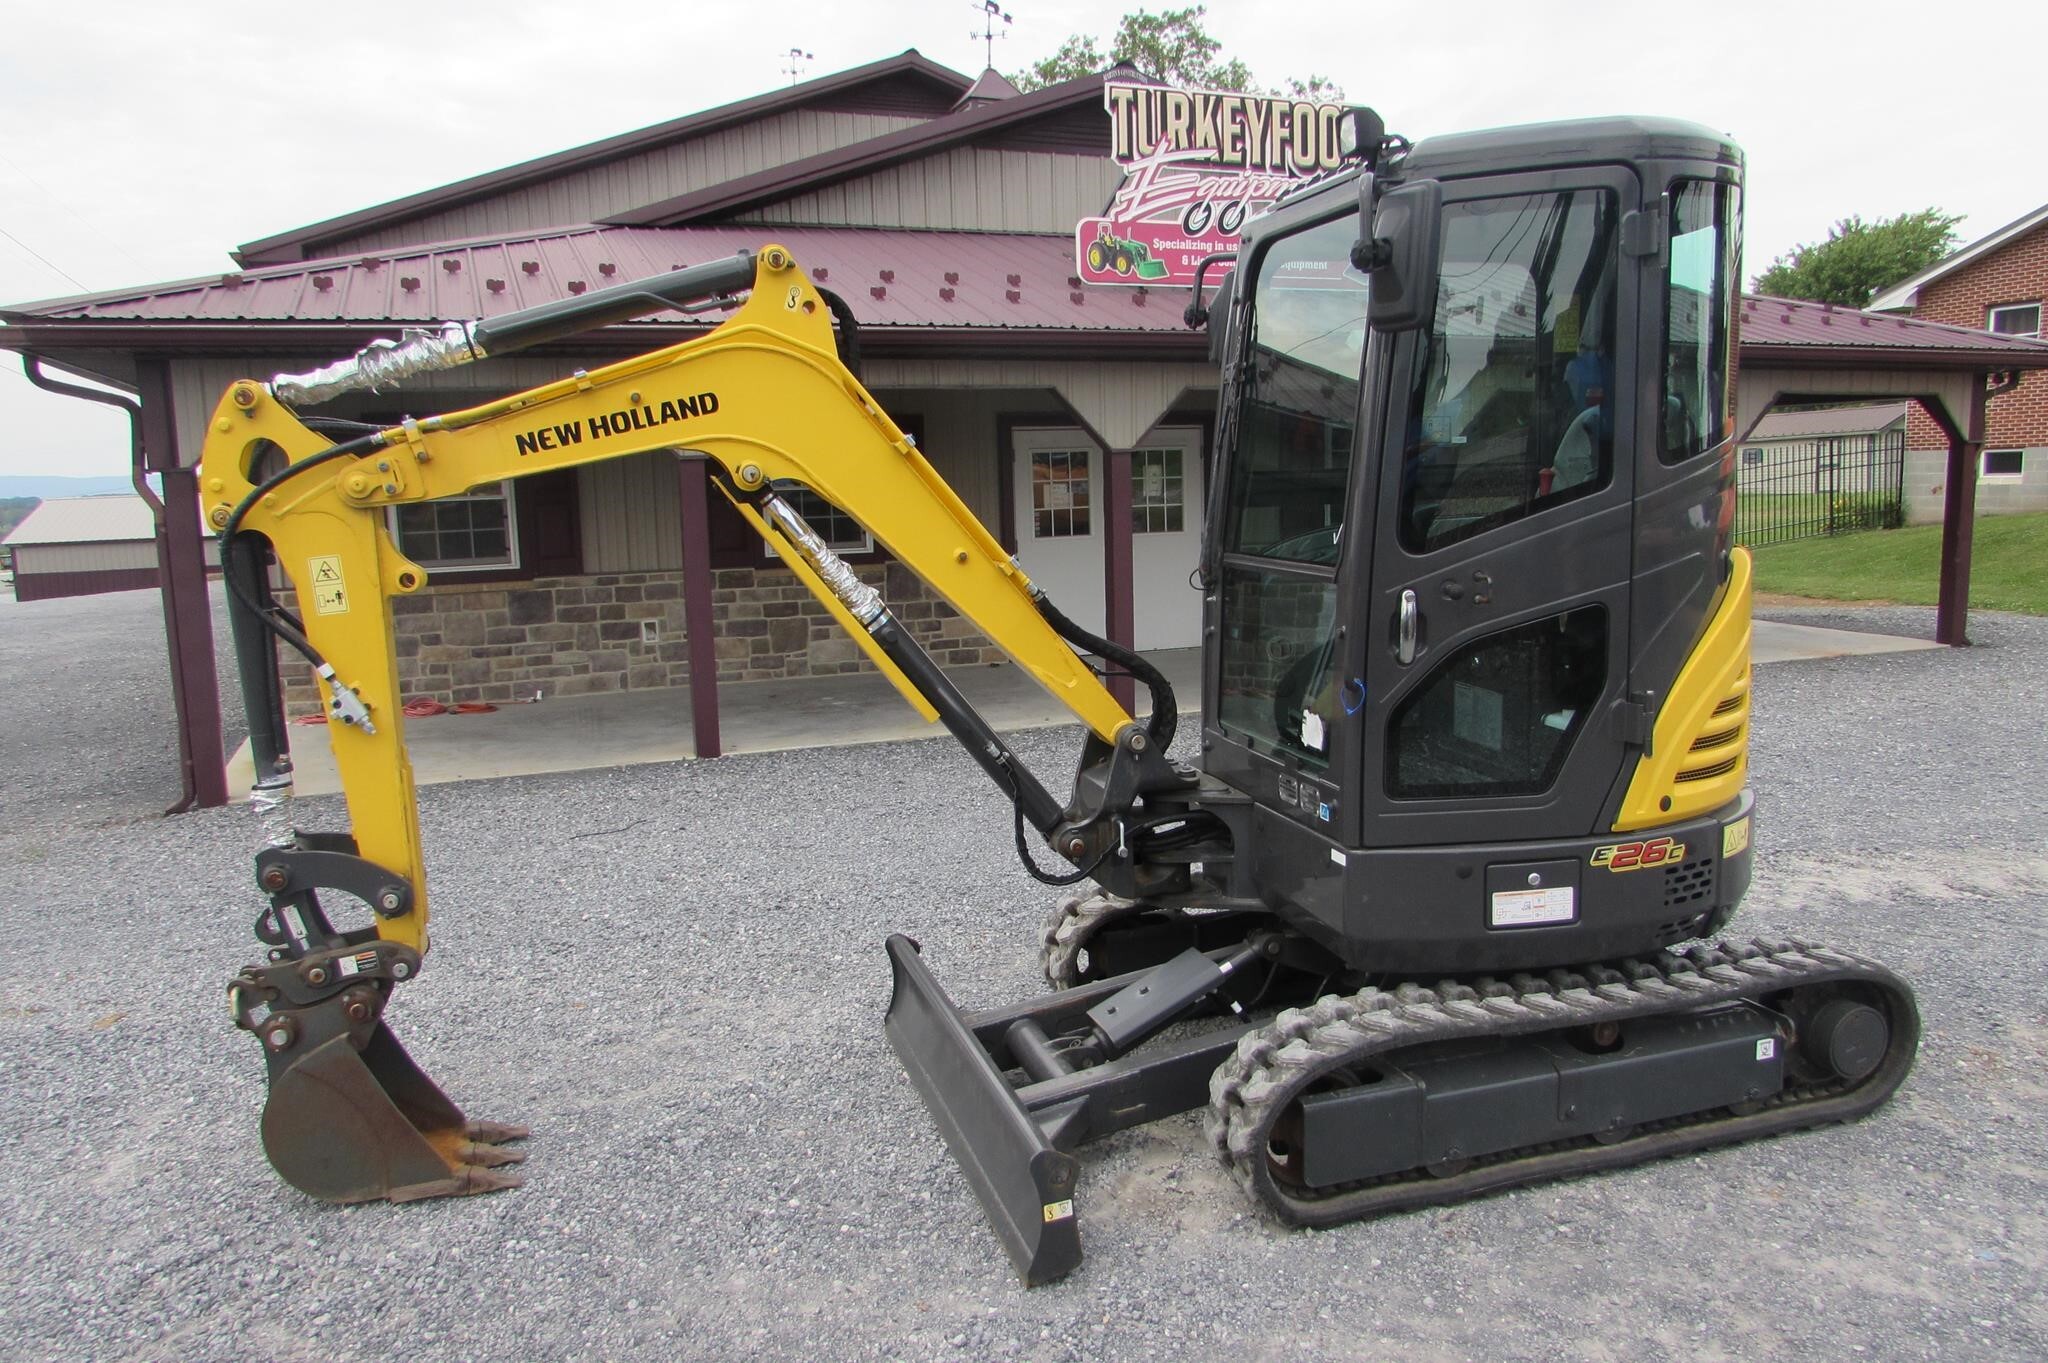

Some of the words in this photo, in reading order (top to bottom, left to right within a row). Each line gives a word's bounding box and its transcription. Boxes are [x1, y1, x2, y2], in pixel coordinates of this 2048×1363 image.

[1109, 86, 1346, 168] TURKEYFOO
[1117, 135, 1298, 225] Equipm
[1153, 238, 1213, 253] Specializing
[1214, 240, 1226, 251] in
[1226, 243, 1238, 252] us
[1280, 260, 1328, 271] quipment
[515, 421, 582, 456] NEW
[588, 392, 720, 440] HOLLAND
[1589, 838, 1685, 871] E26C
